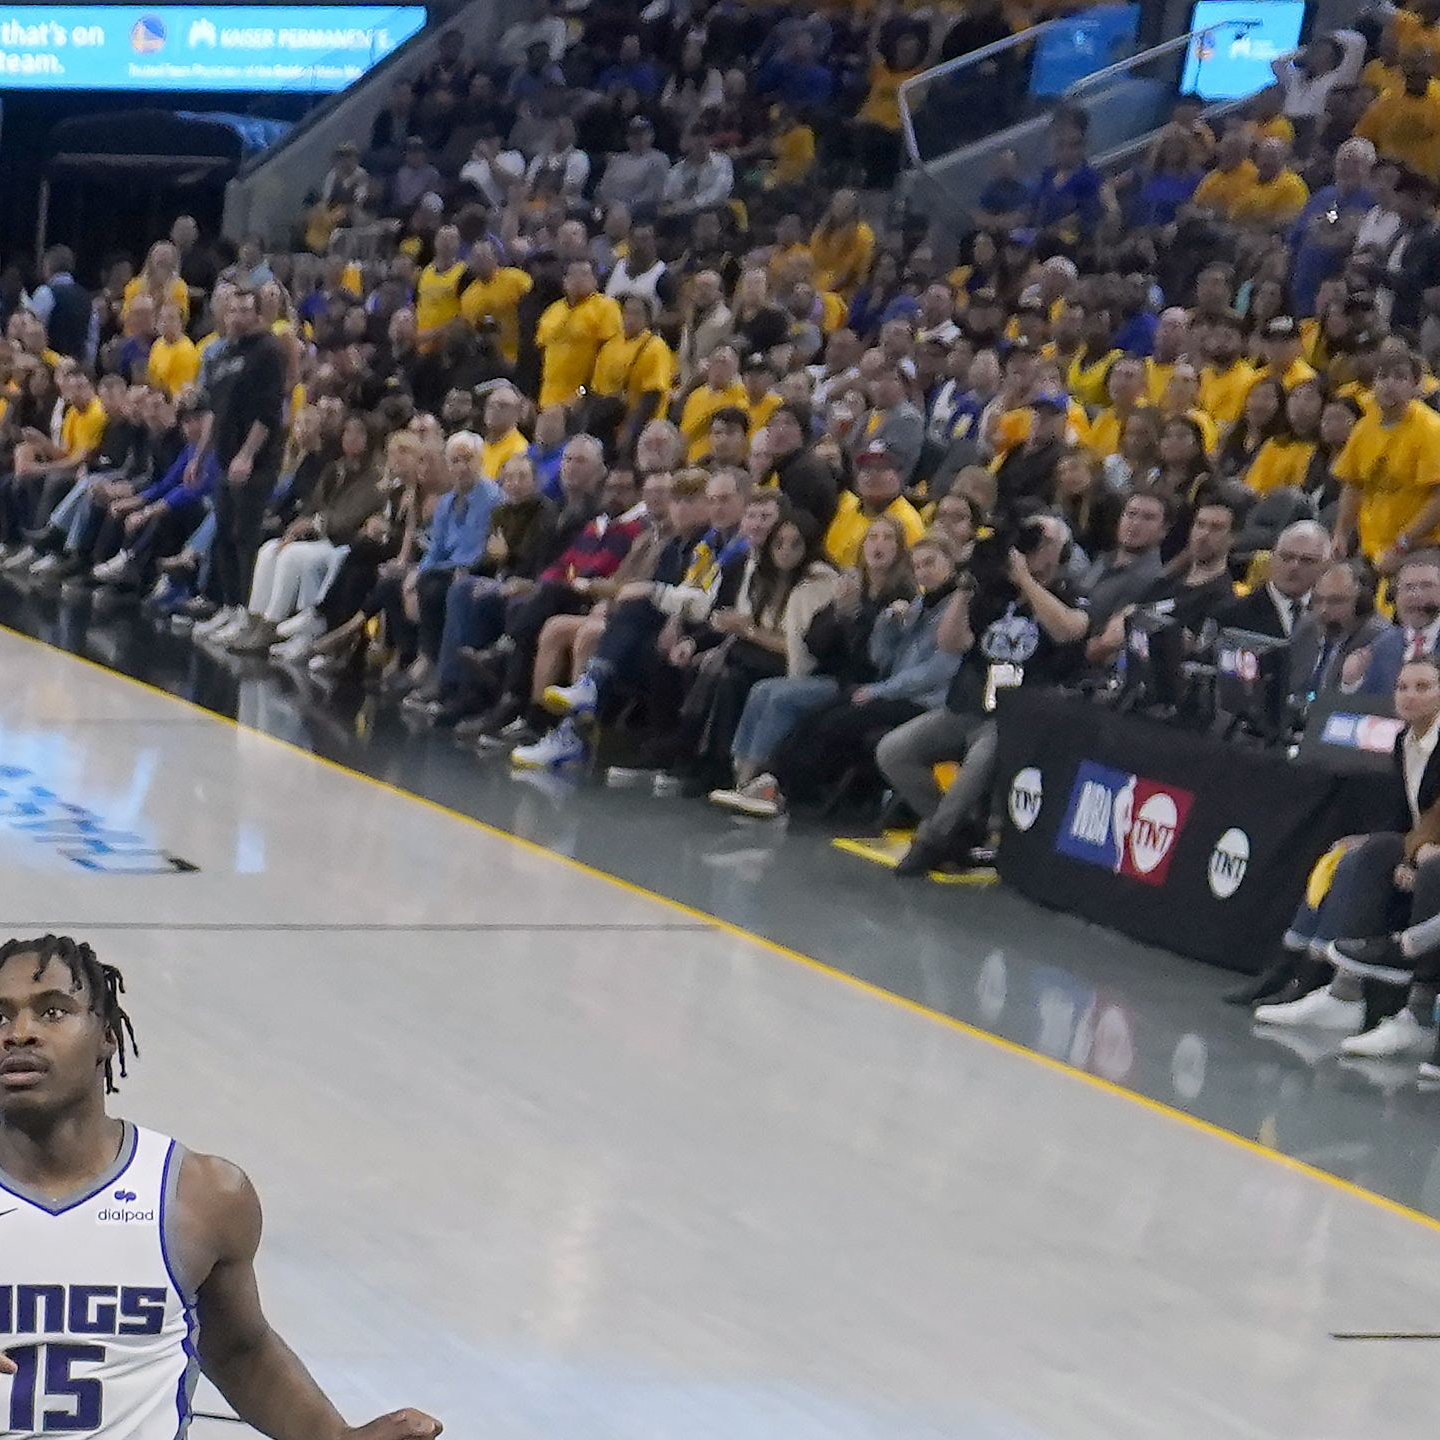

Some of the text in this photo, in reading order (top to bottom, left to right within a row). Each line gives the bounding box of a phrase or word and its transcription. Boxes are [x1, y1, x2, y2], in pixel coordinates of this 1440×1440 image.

[1, 18, 68, 46] that's
[73, 26, 105, 47] on
[221, 28, 388, 49] KAISER PERMANENE
[97, 1208, 154, 1223] dialpad
[4, 1342, 106, 1431] 15
